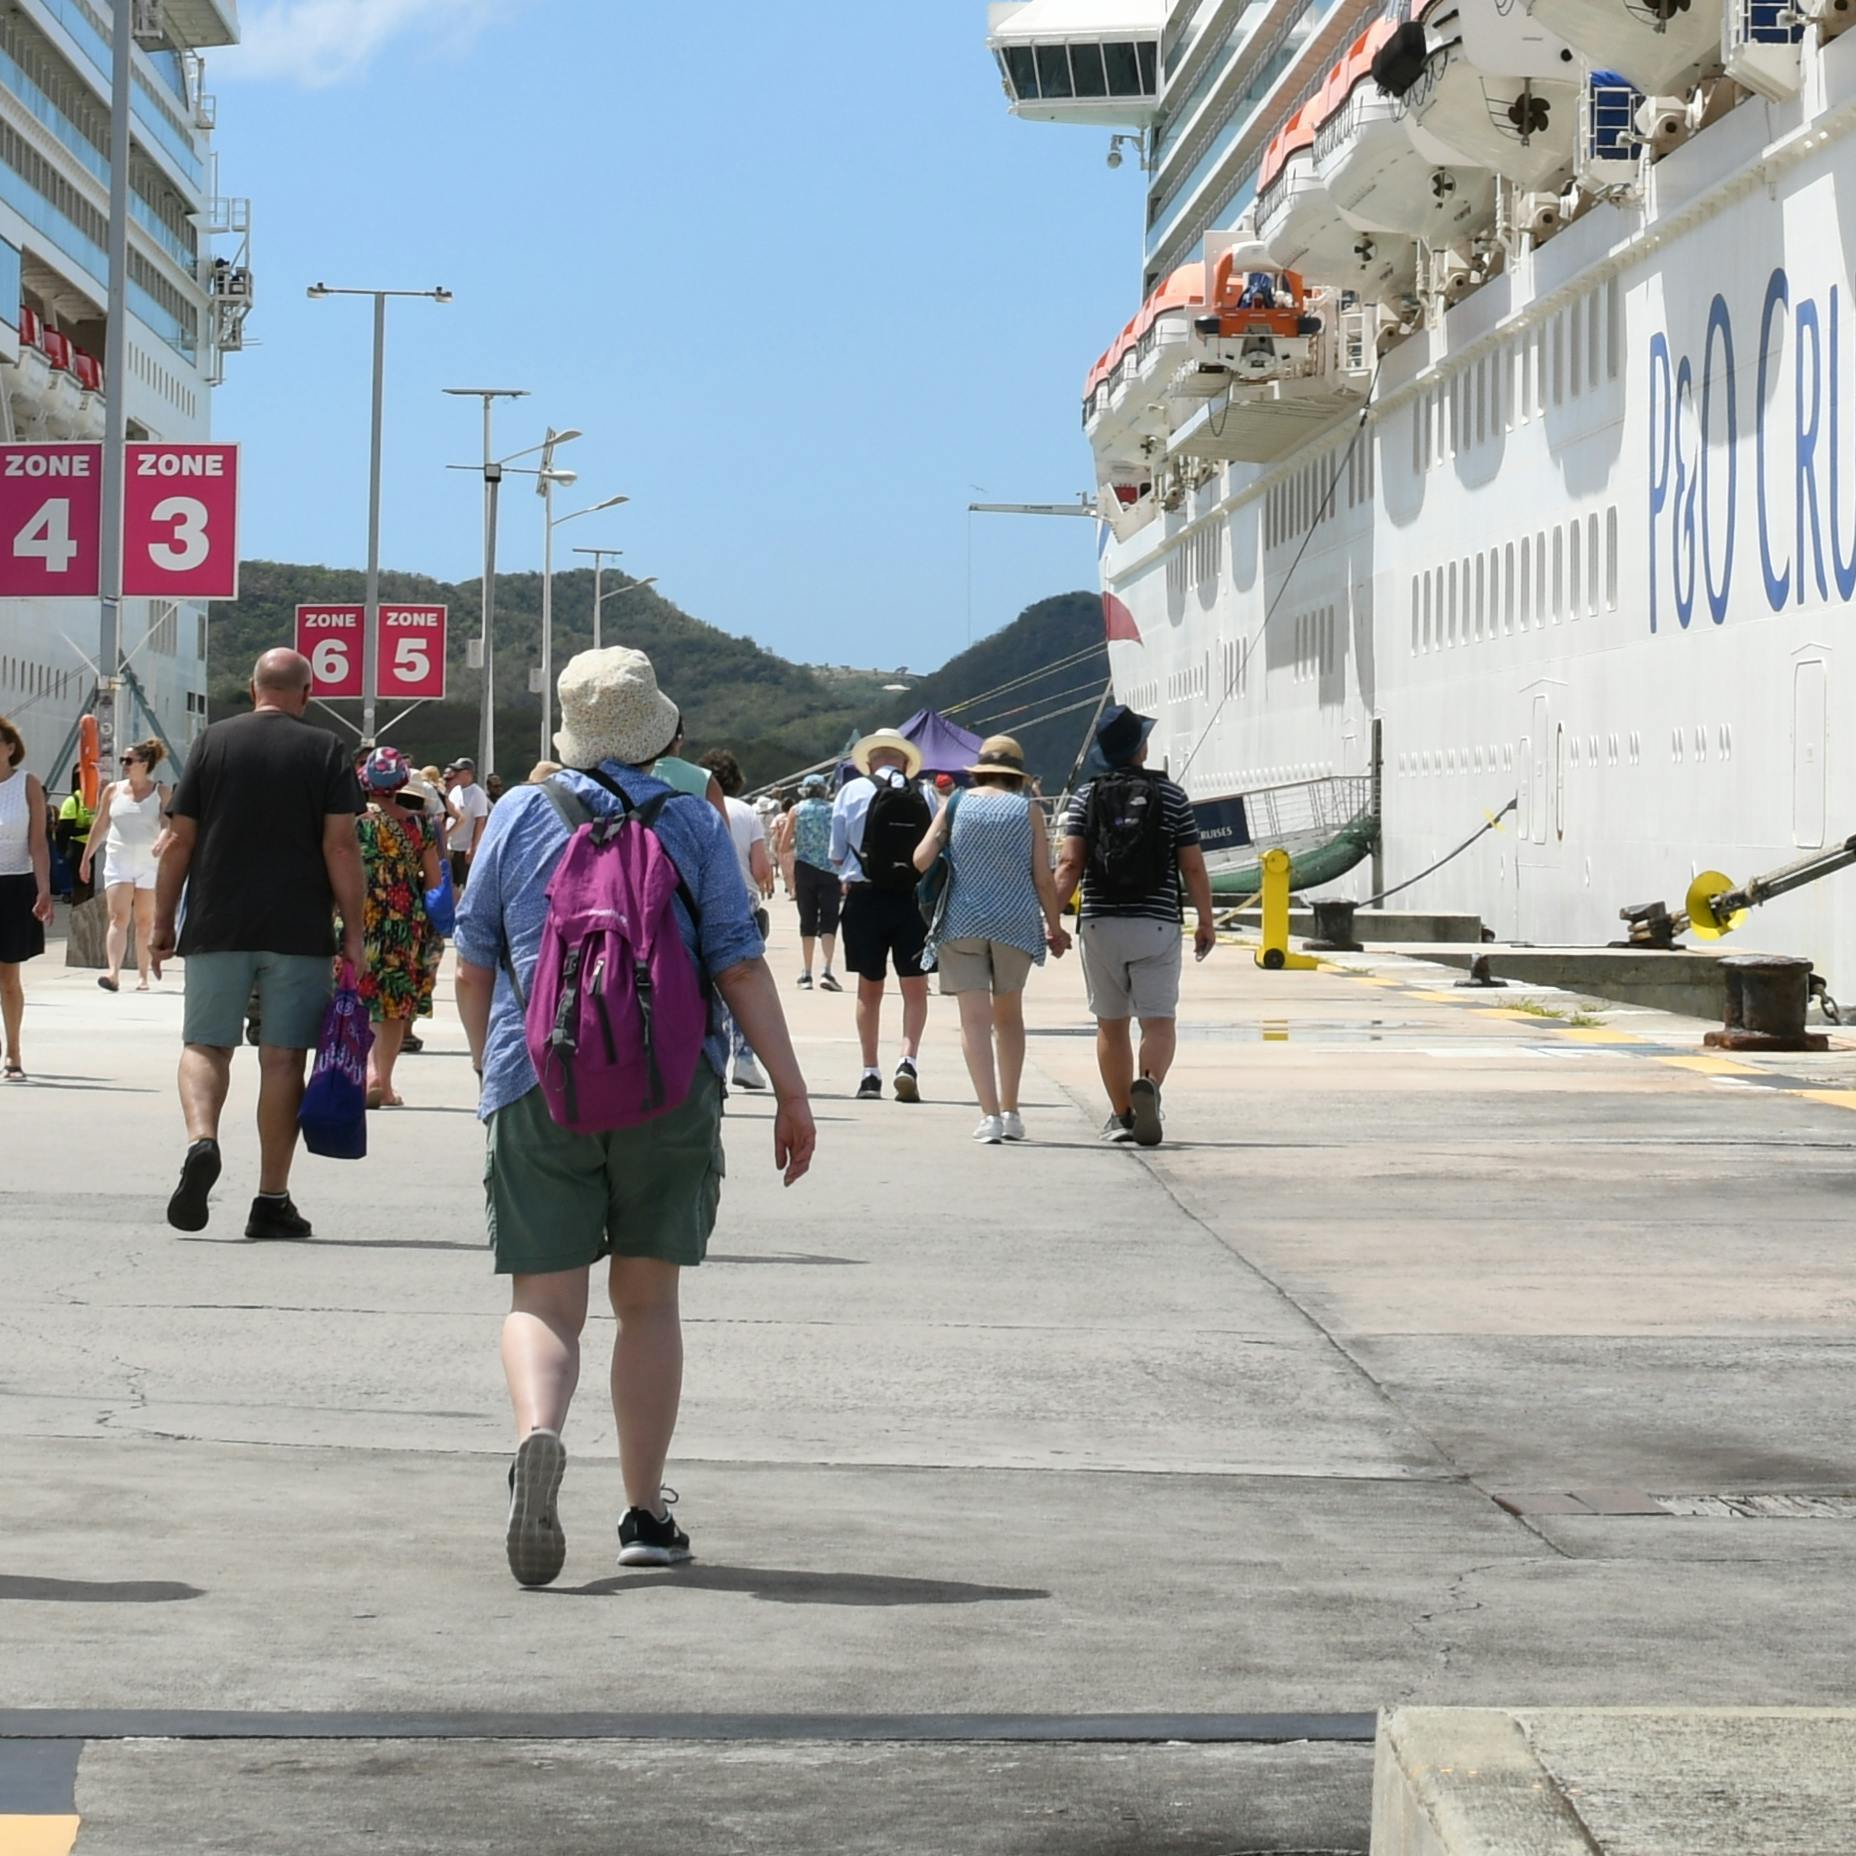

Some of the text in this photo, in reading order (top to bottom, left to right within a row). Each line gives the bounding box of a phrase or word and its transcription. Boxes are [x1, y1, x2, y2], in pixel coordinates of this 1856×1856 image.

[5, 455, 90, 477] ZONE
[137, 454, 224, 477] ZONE
[1649, 293, 1737, 634] P&O
[13, 498, 77, 572] 4
[148, 496, 210, 572] 3
[305, 613, 356, 627] ZONE
[386, 612, 438, 627] ZONE
[311, 638, 349, 683] 6
[393, 637, 430, 682] 5
